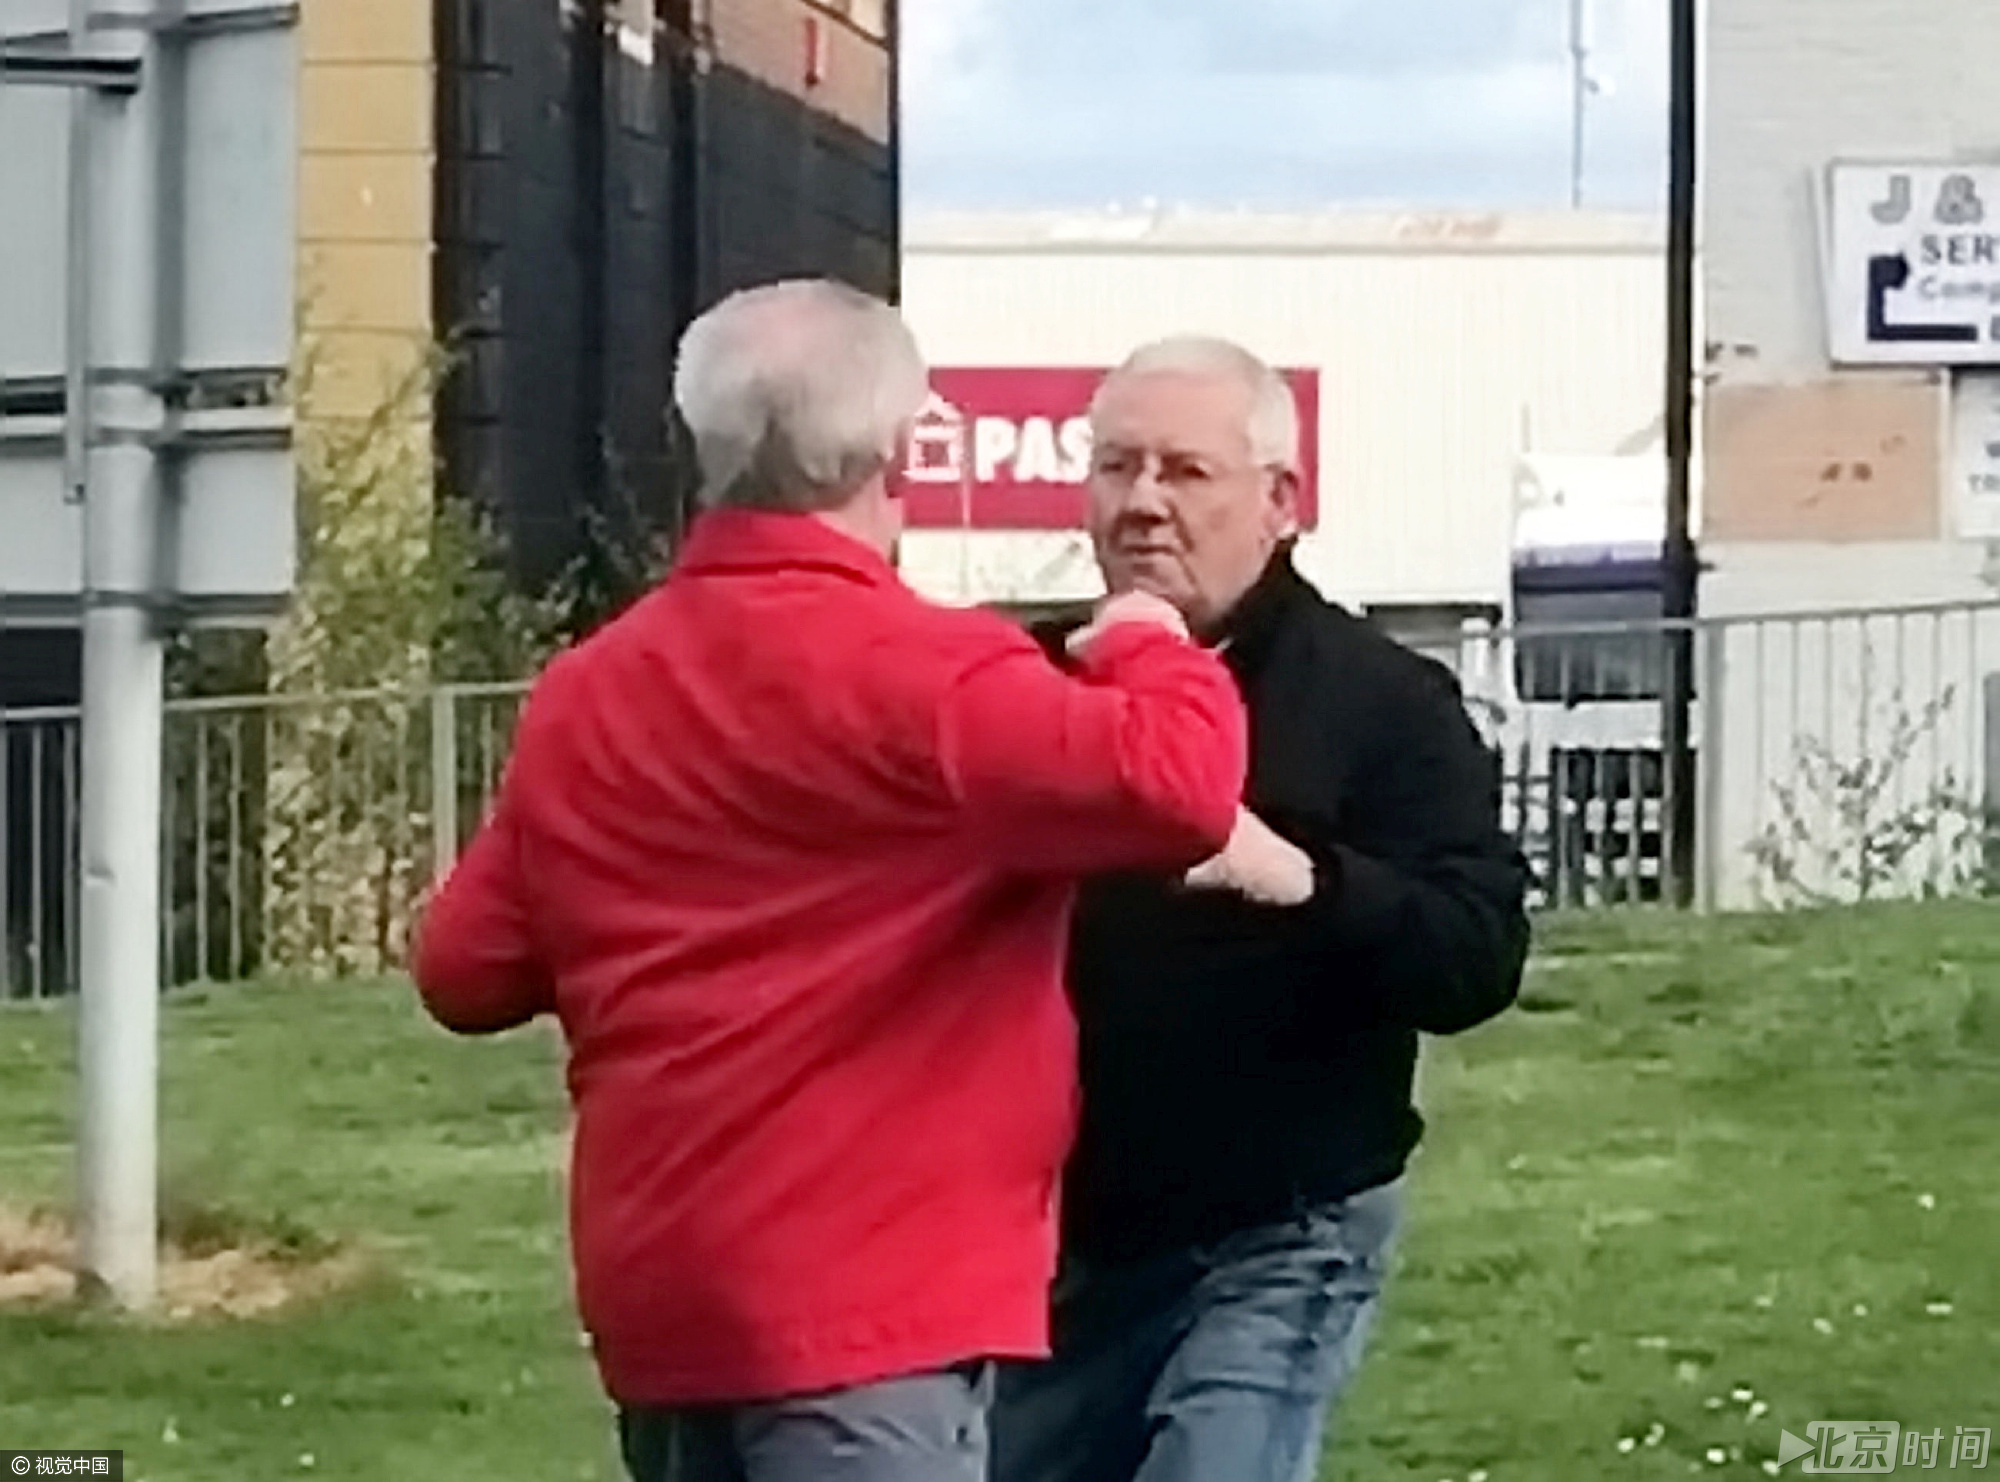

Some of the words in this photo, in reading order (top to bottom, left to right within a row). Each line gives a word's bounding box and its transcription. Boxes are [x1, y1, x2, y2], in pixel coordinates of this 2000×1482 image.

[1869, 174, 1911, 225] J
[1934, 174, 1984, 226] &
[1920, 233, 2000, 266] SER
